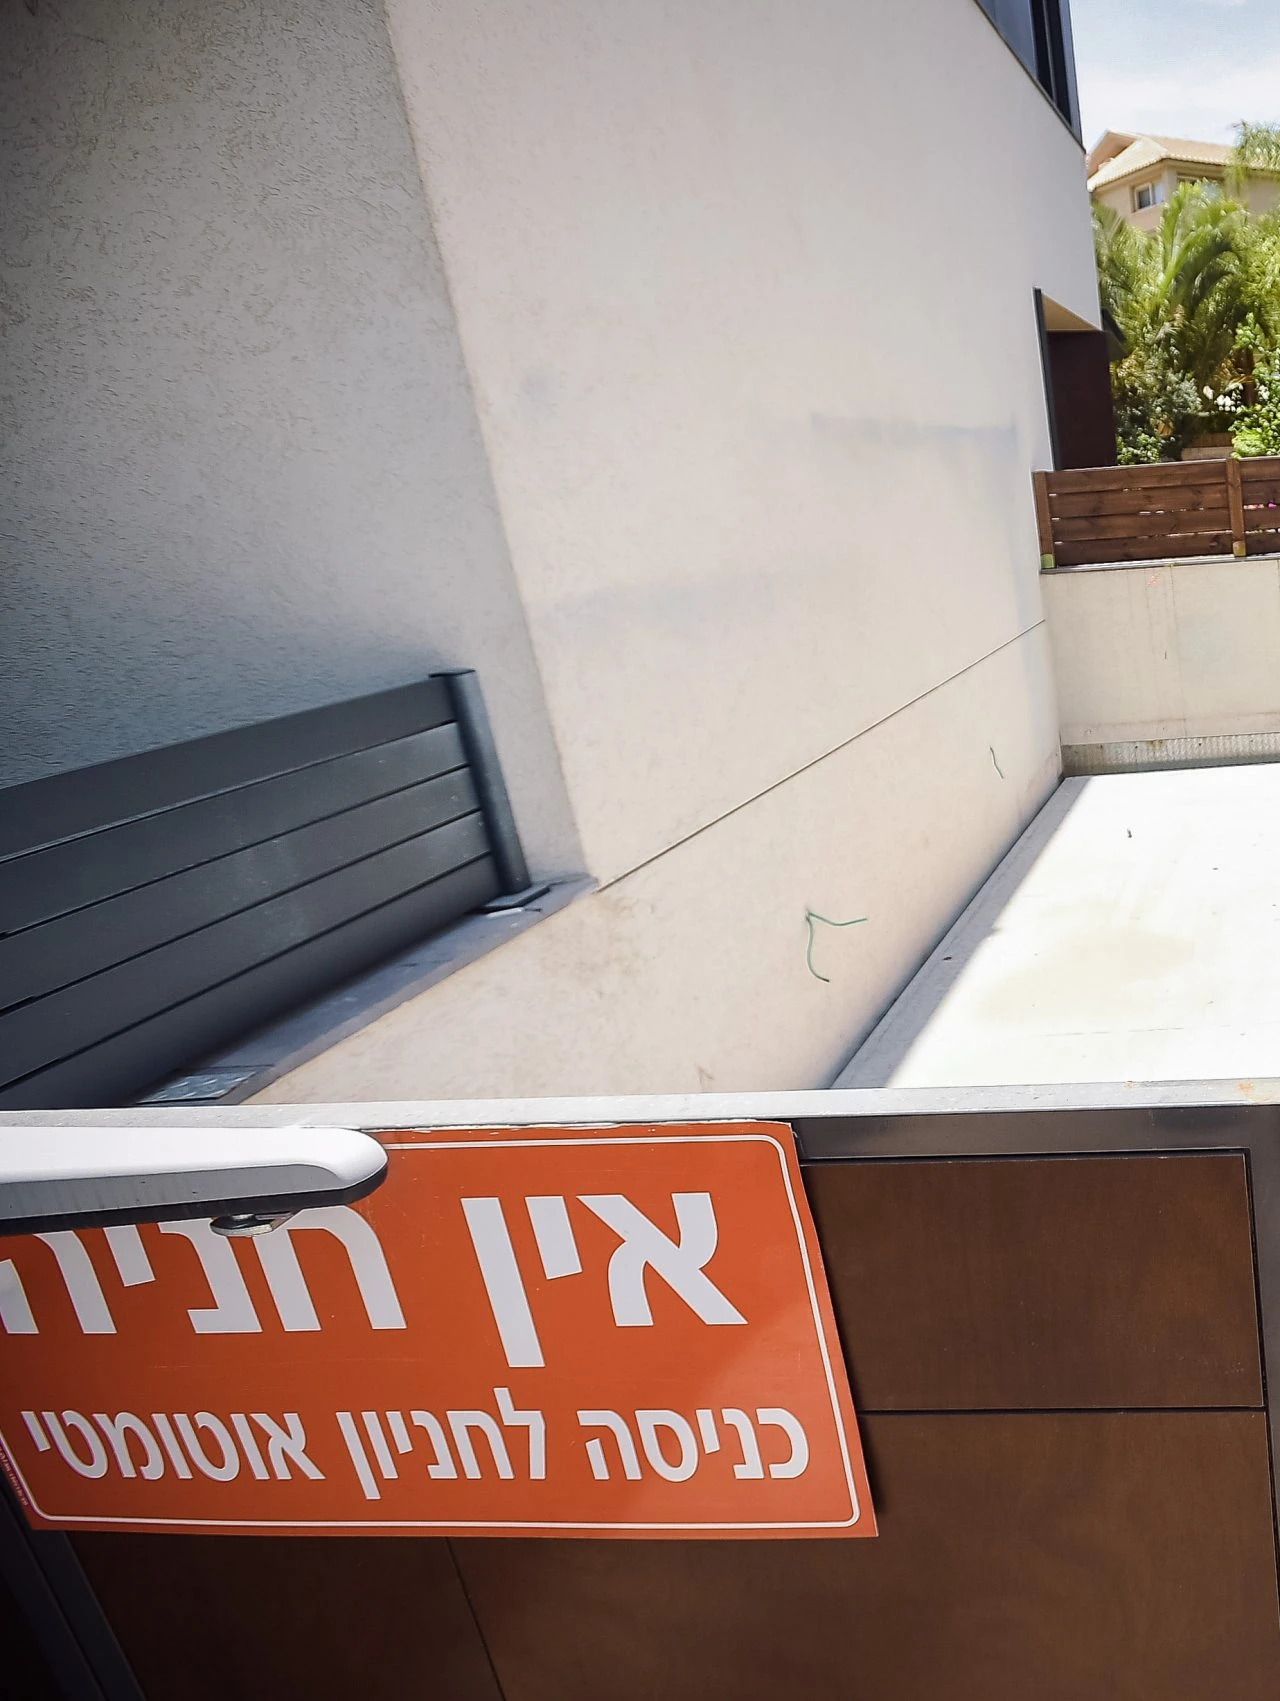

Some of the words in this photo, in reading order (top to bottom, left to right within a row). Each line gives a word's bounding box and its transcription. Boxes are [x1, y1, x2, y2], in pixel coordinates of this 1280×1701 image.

[461, 1192, 747, 1368] אין
[20, 1410, 325, 1482] אוטומטי
[336, 1387, 546, 1500] לחניון
[576, 1407, 809, 1481] כניסה
